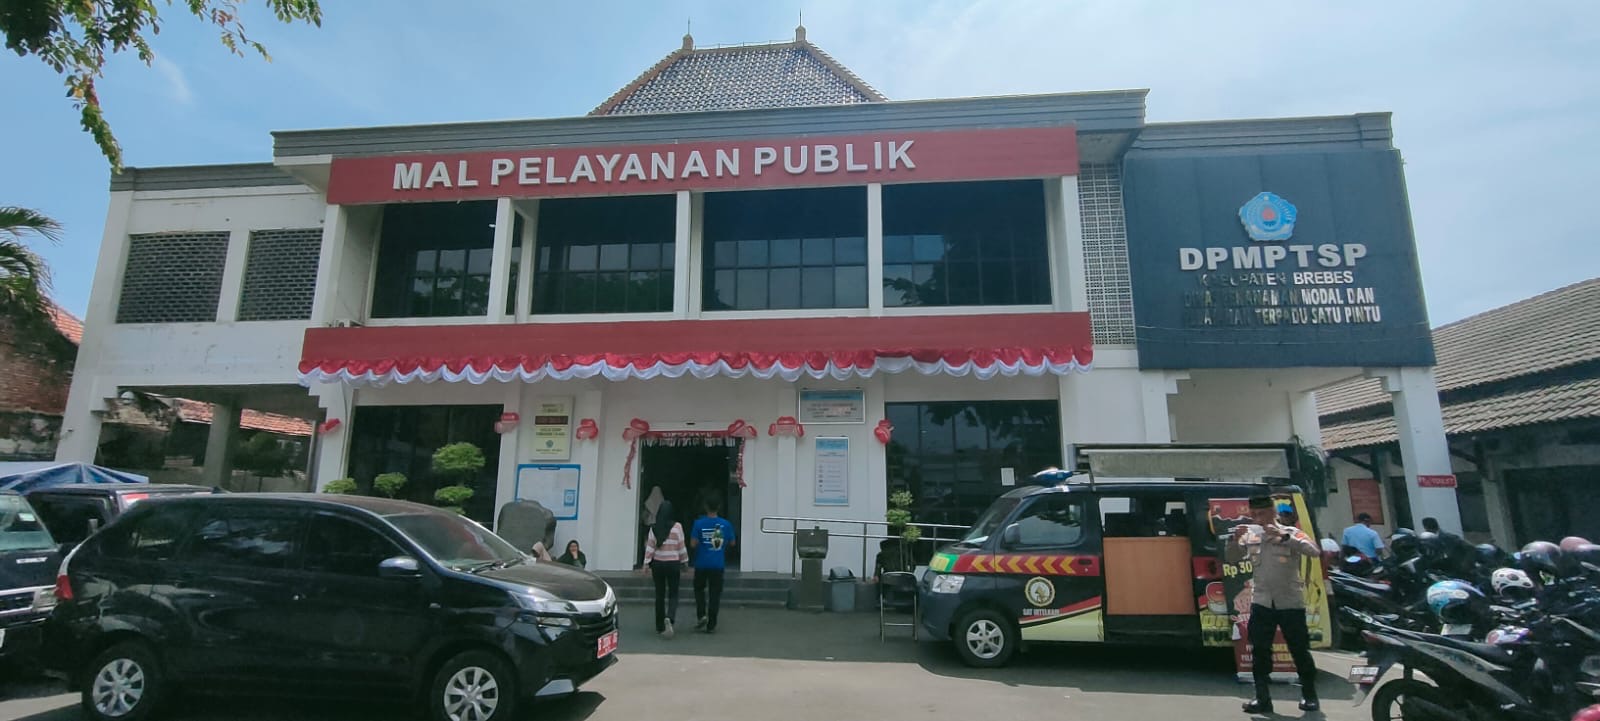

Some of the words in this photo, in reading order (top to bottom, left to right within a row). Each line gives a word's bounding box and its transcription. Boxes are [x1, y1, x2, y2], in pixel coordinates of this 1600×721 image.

[393, 160, 478, 189] MAL
[491, 149, 740, 186] PELAYANAN
[754, 140, 916, 176] PUBLIK
[1179, 244, 1367, 271] DPMPTSP
[1200, 272, 1287, 286] KBUPATEN
[1293, 271, 1354, 285] BREBES
[1183, 290, 1216, 307] DINA
[1223, 289, 1300, 306] NANAMAN
[1301, 288, 1343, 305] MODAL
[1347, 287, 1375, 305] DAN
[1255, 307, 1308, 325] TERPADU
[1312, 306, 1342, 324] SATU
[1345, 306, 1381, 323] PINTU
[1222, 564, 1238, 578] Rp
